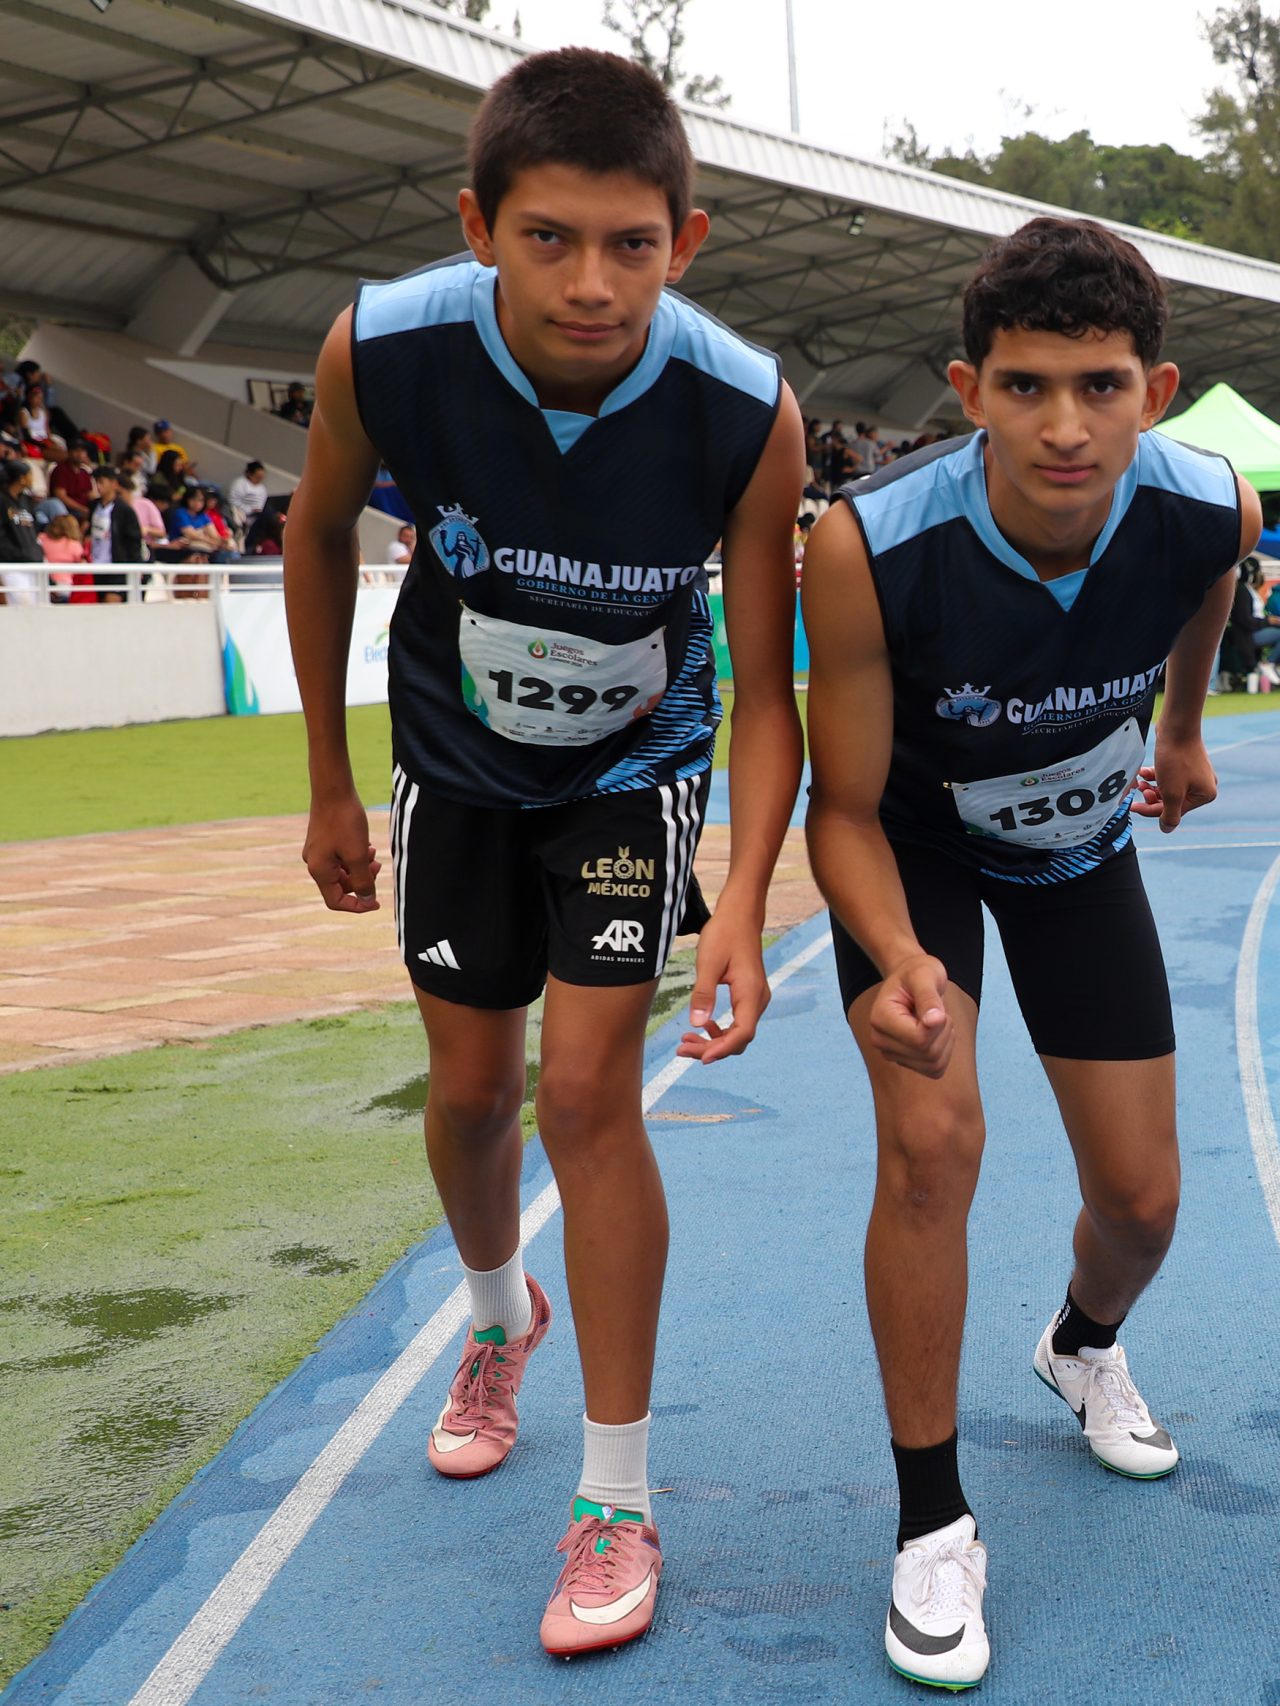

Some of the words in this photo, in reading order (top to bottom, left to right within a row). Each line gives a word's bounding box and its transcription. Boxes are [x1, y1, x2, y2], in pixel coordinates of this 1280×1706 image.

[493, 547, 699, 593] GUANAJUATO
[516, 578, 587, 598] GOBIERNO
[590, 587, 607, 600] DE
[612, 591, 629, 603] LA
[550, 650, 598, 666] Escolares
[488, 669, 640, 715] 1299
[1006, 656, 1168, 724] GUANAJUAT
[1085, 704, 1100, 715] DE
[1103, 700, 1118, 709] LA
[989, 769, 1128, 831] 1308
[586, 879, 651, 898] MÉXICO
[590, 919, 646, 953] AR
[590, 954, 615, 962] ADIDAS
